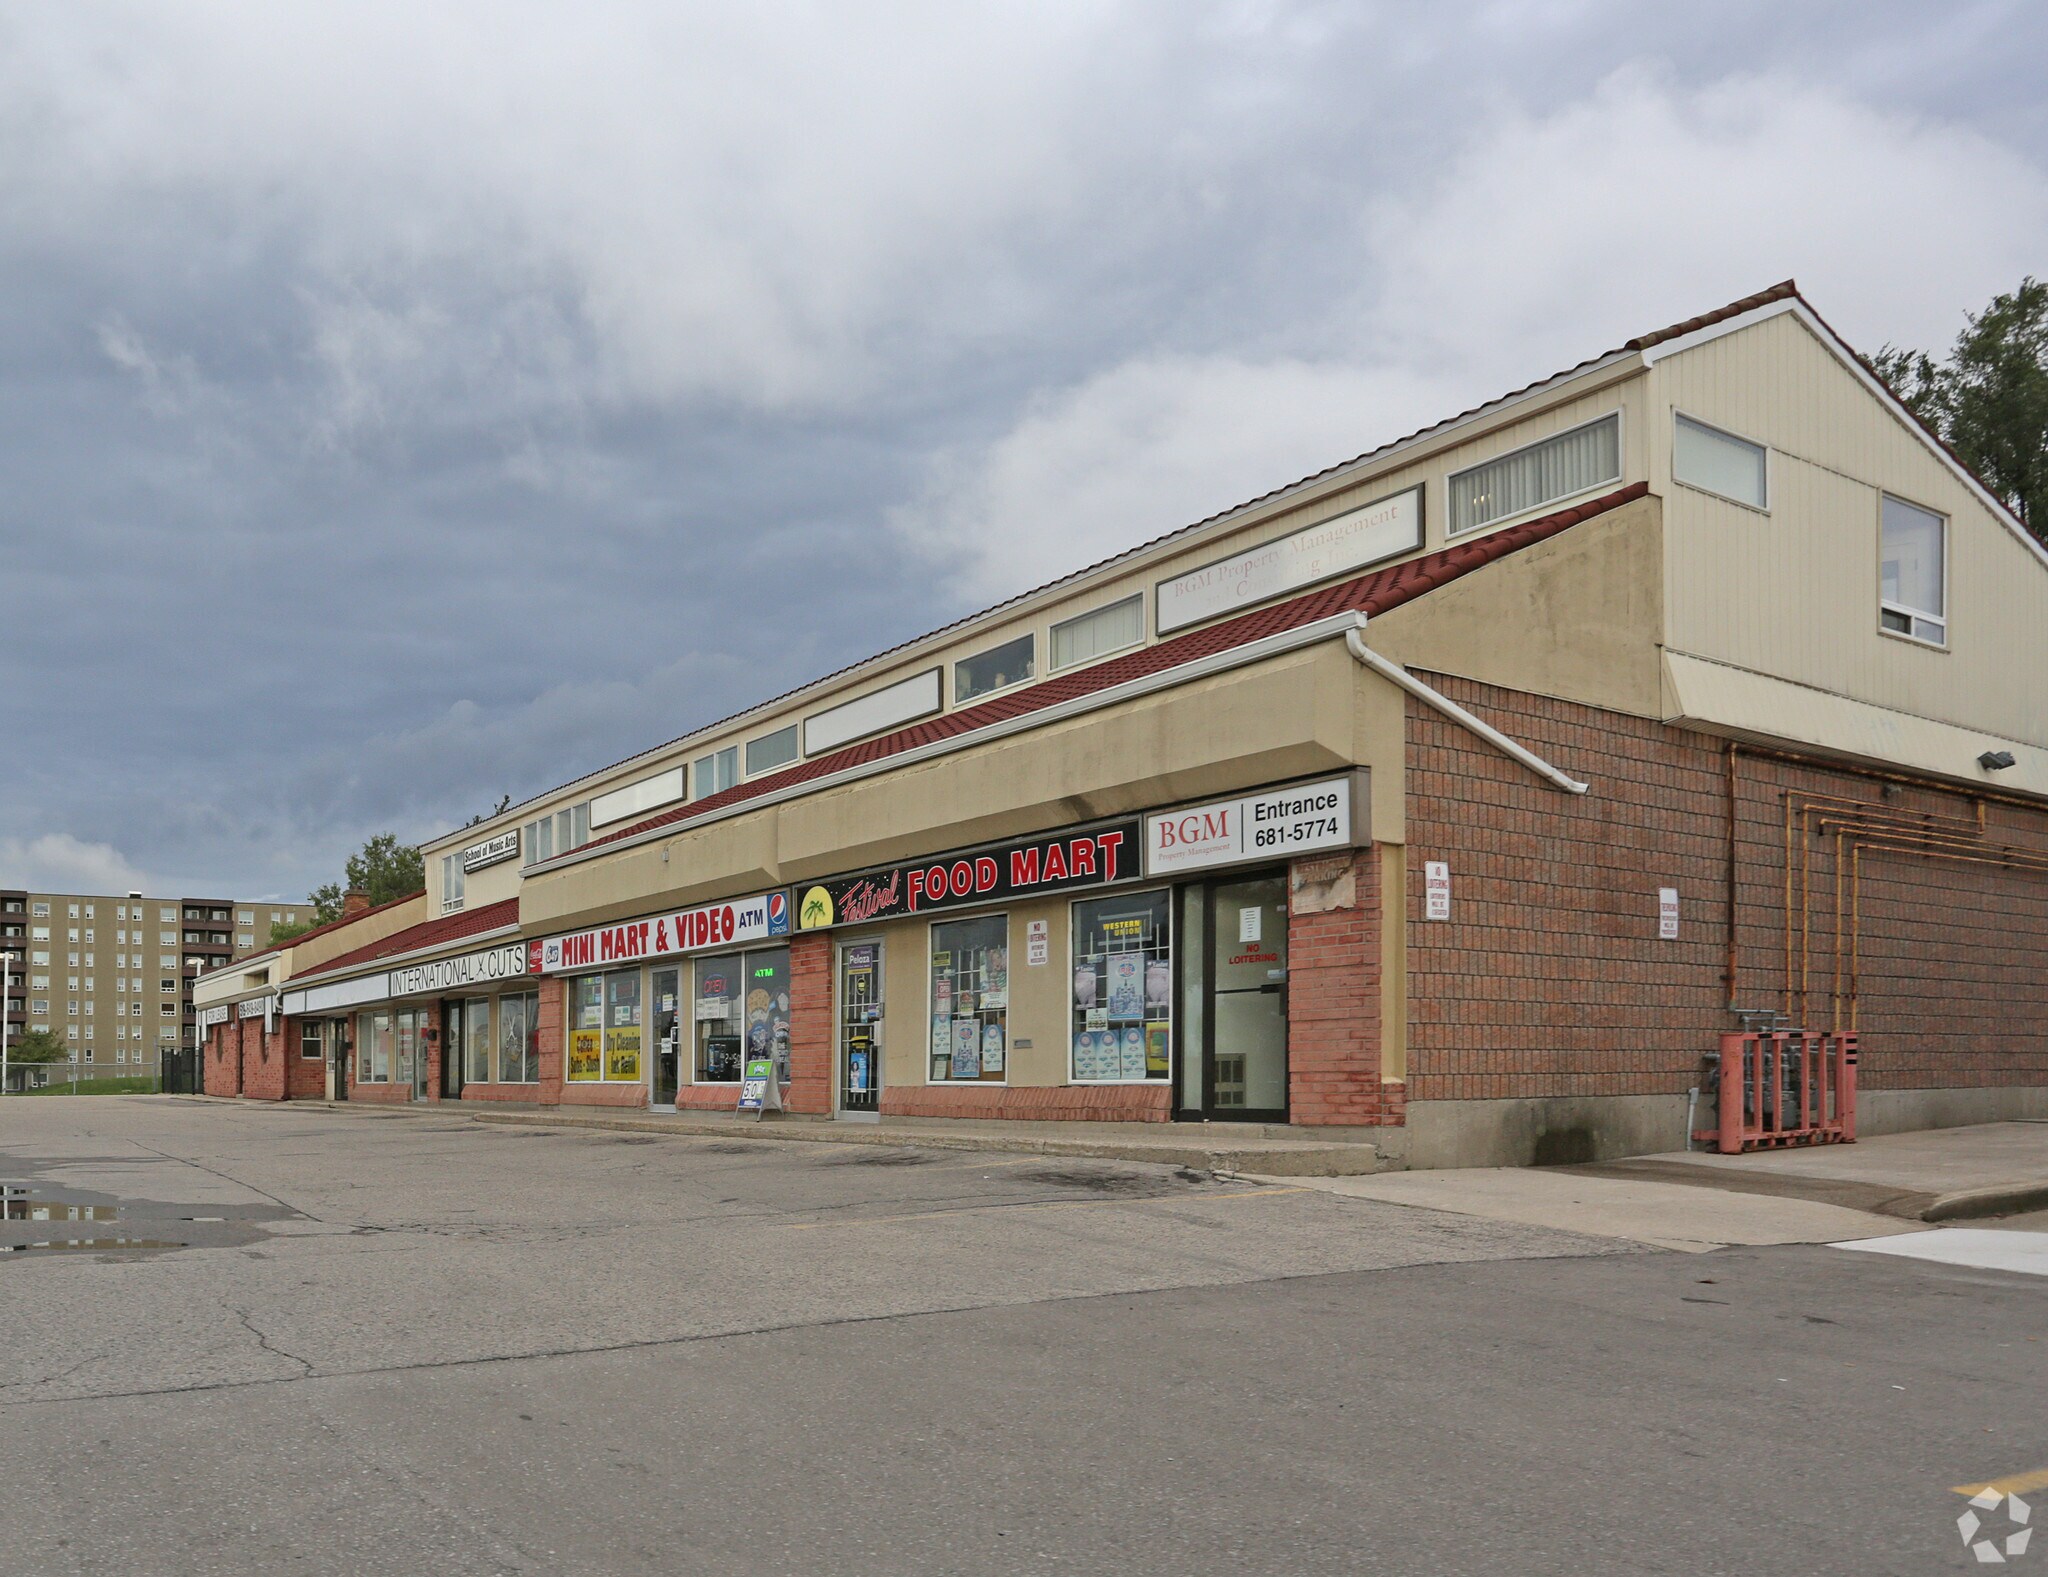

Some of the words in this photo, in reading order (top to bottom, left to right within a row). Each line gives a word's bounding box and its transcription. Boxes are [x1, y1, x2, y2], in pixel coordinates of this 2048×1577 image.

[1174, 572, 1212, 598] BGM
[1218, 551, 1281, 583] Property
[1289, 504, 1398, 557] Management
[1255, 793, 1338, 822] Entrance
[1158, 809, 1230, 849] BGM
[1255, 817, 1338, 847] 681-5774
[465, 847, 481, 863] School
[489, 839, 504, 855] Music
[505, 835, 517, 849] Arts
[1157, 850, 1185, 862] Property
[1188, 843, 1230, 857] Management
[839, 869, 899, 922] Festival
[907, 856, 998, 913] FOOD
[1010, 830, 1124, 888] MART
[561, 932, 595, 967] MINI
[601, 922, 649, 961] MART
[655, 919, 669, 953] &
[675, 905, 735, 949] VIDEO
[739, 908, 764, 929] ATM
[771, 924, 788, 935] pepsi
[1102, 919, 1142, 931] WESTERN
[1114, 927, 1142, 936] UNION
[850, 954, 870, 965] Peloza
[1229, 953, 1278, 965] LOITERING
[1246, 943, 1260, 953] NO
[392, 957, 474, 995] INTERNATIONAL
[488, 946, 524, 978] CUTS
[754, 968, 774, 978] ATM
